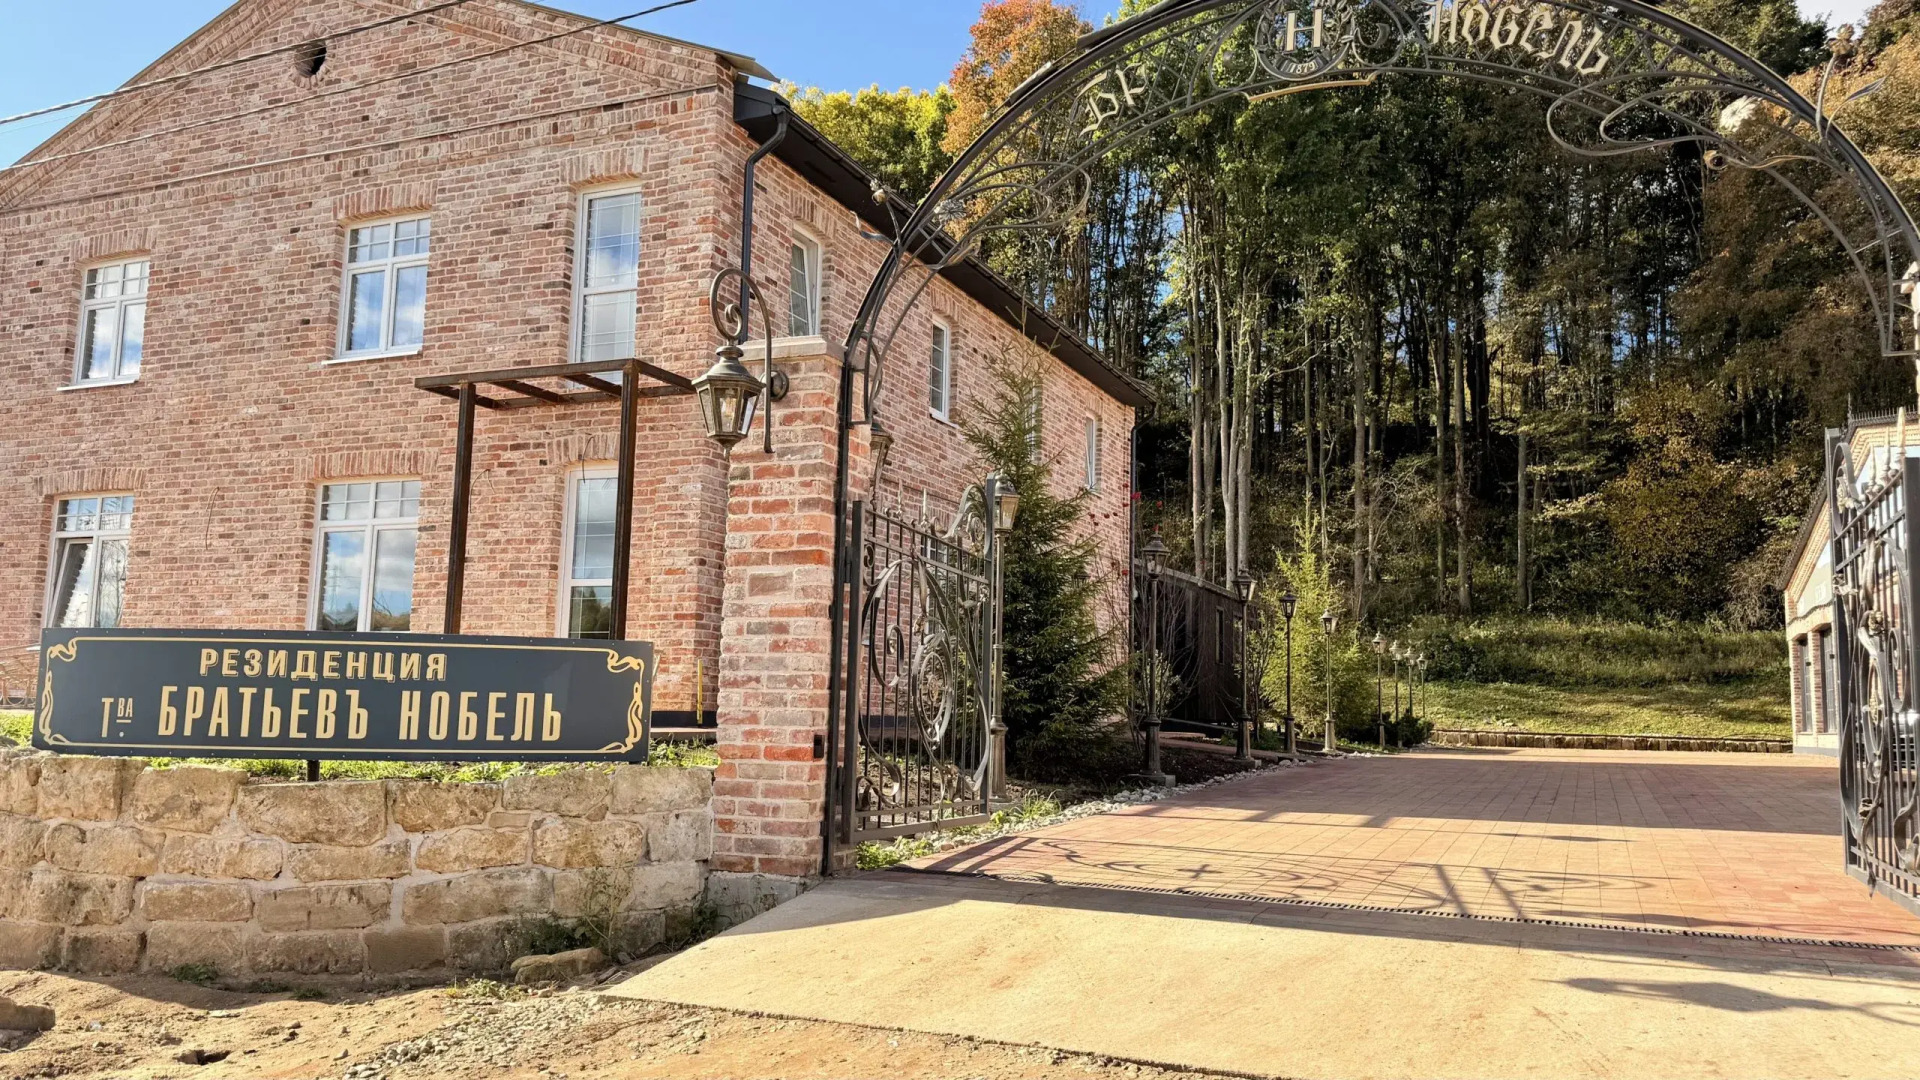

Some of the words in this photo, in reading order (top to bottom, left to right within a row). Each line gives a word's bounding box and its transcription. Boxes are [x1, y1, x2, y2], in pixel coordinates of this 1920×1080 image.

[1288, 61, 1317, 75] 1879
[199, 648, 447, 683] РЕЗИДЕНЦИЯ
[157, 685, 369, 740] БРАТЬЕВЪ
[398, 690, 562, 742] НОБЕЛЬ
